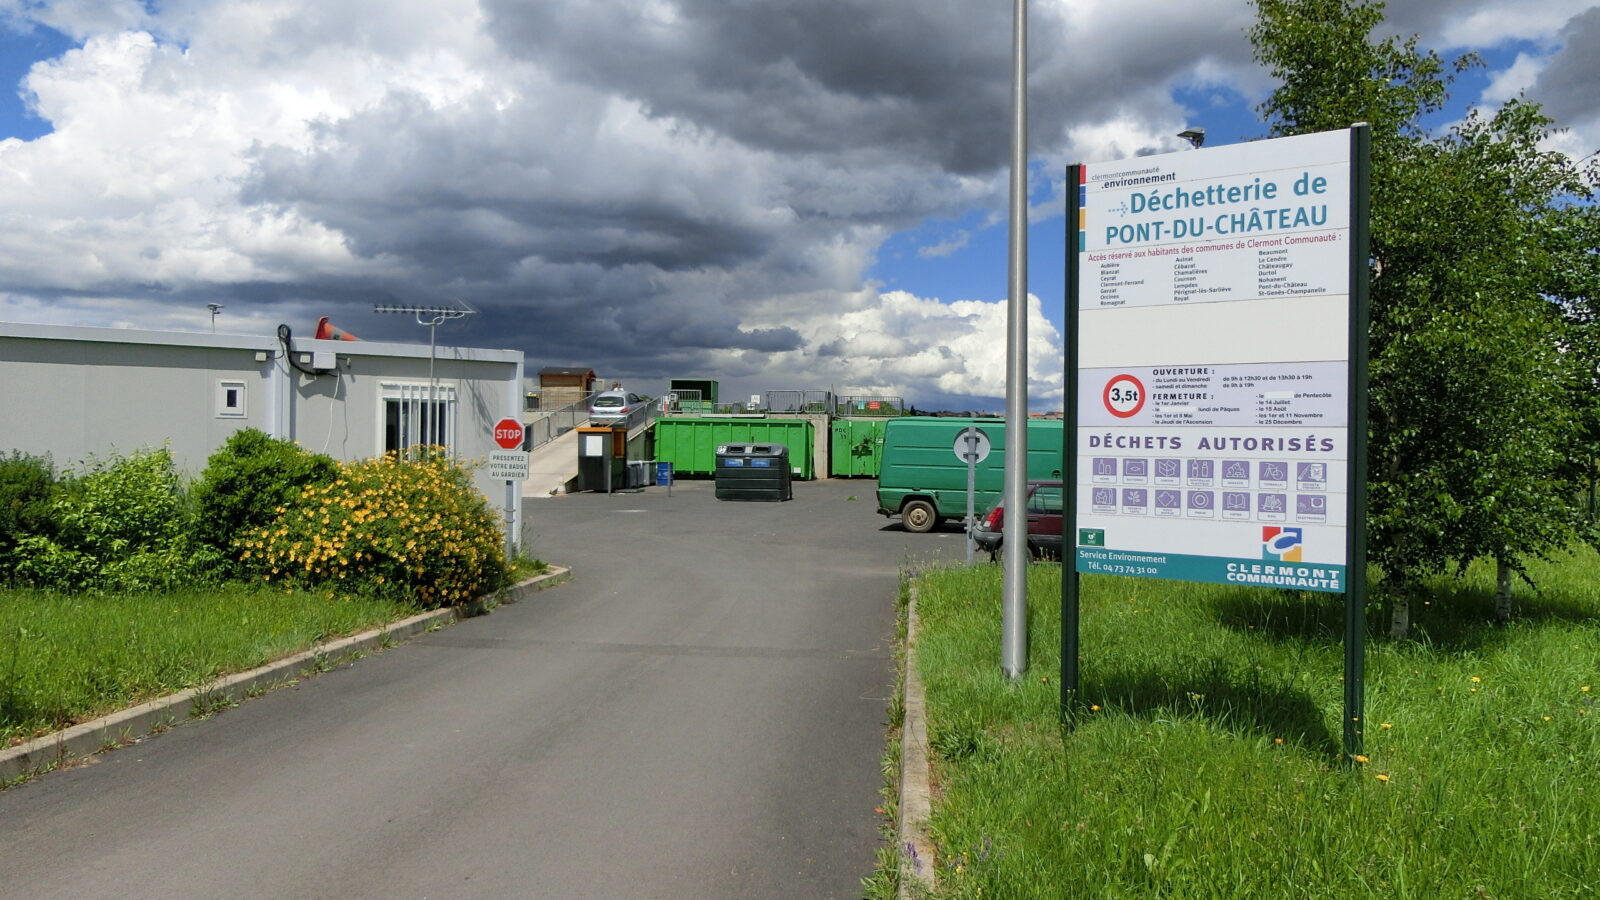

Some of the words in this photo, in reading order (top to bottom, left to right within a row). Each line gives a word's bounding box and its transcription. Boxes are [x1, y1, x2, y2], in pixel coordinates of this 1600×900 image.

[1092, 166, 1160, 181] clermontcommunauté
[1130, 178, 1278, 214] Déchetterie
[1293, 172, 1327, 196] de
[1106, 204, 1327, 245] PONT-DU-CHÂTEAU
[1088, 254, 1107, 262] Accès
[1108, 251, 1132, 260] réservé
[1134, 250, 1146, 258] aux
[1148, 247, 1180, 257] habitants
[1182, 245, 1194, 254] des
[1196, 242, 1234, 252] communes
[1236, 241, 1245, 249] de
[1247, 238, 1282, 248] Clermont
[1285, 233, 1337, 245] Communauté
[1259, 248, 1288, 256] Beaumont
[1258, 282, 1308, 290] Pont-du-Château
[1152, 368, 1209, 376] OUVERTURE
[1112, 388, 1138, 404] 3,5t
[496, 429, 521, 440] STOP
[1089, 433, 1182, 449] DÉCHETS
[1197, 434, 1334, 452] AUTORISÉS
[1080, 550, 1107, 560] Service
[1108, 552, 1166, 564] Environnement
[1114, 565, 1124, 573] 73
[1126, 566, 1135, 574] 74
[1226, 563, 1340, 579] CLERMONT
[1226, 573, 1339, 589] COMMUNAUTÉ
